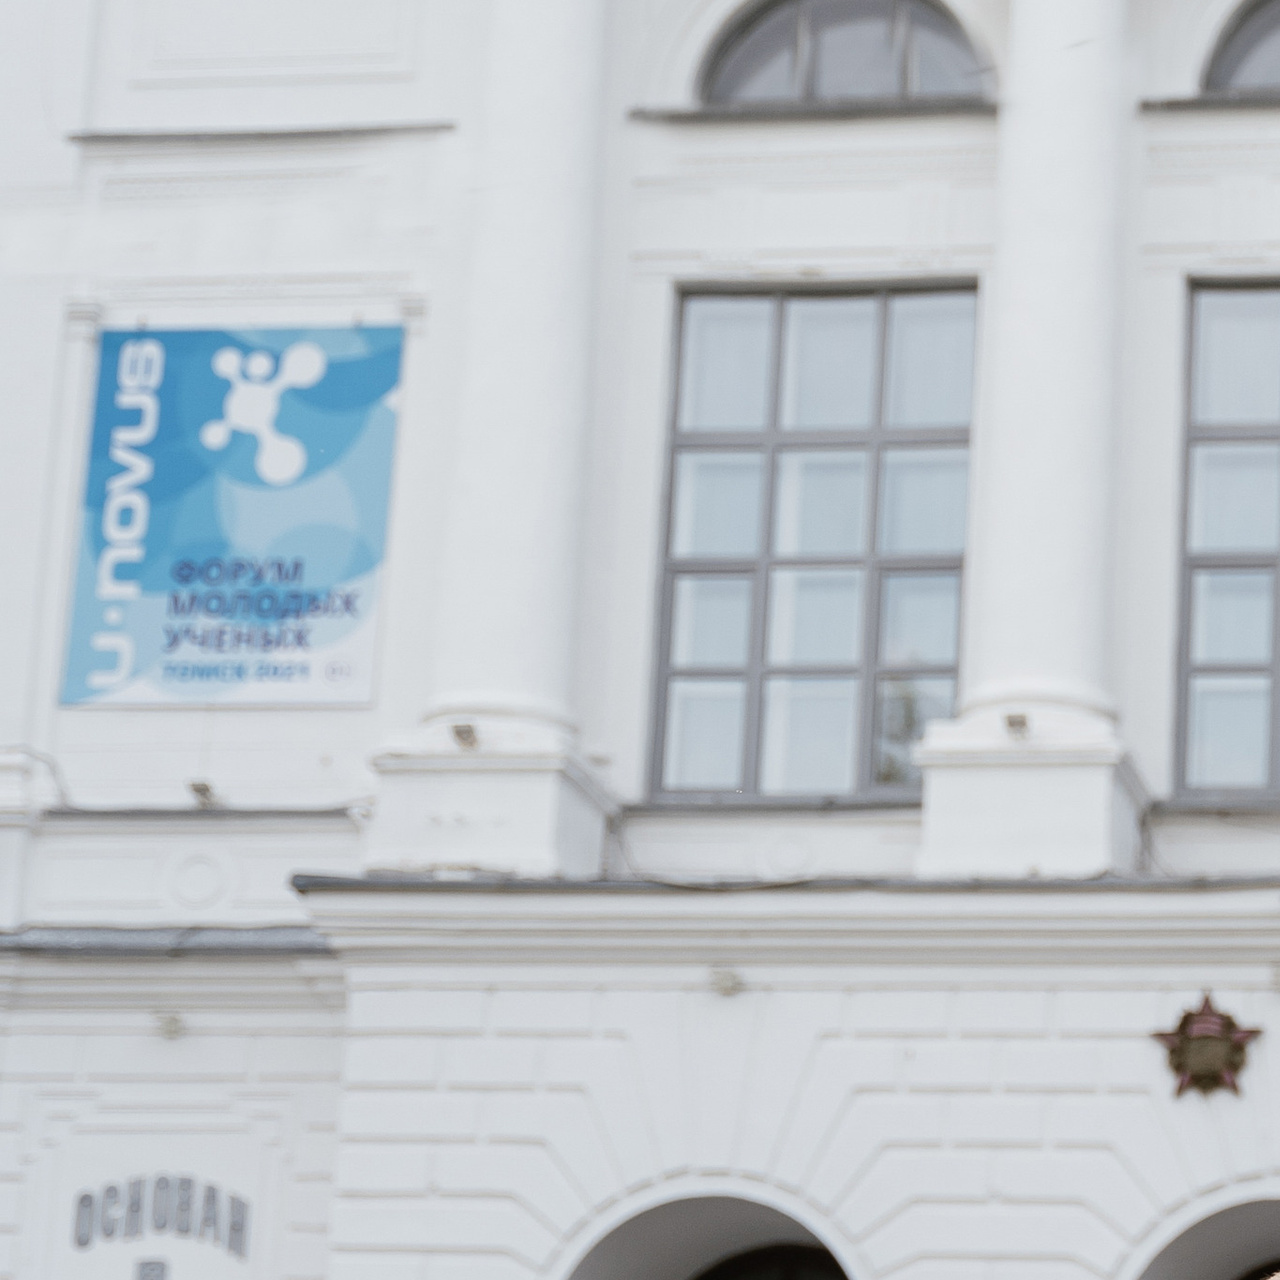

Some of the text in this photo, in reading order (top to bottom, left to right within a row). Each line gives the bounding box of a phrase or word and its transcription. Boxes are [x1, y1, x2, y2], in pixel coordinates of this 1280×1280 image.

[171, 558, 305, 585] ФОРУМ
[167, 590, 361, 619] МОЛОДЫХ
[163, 624, 311, 653] УЧЕНЫХ
[74, 1176, 248, 1260] ОСНОВАН
